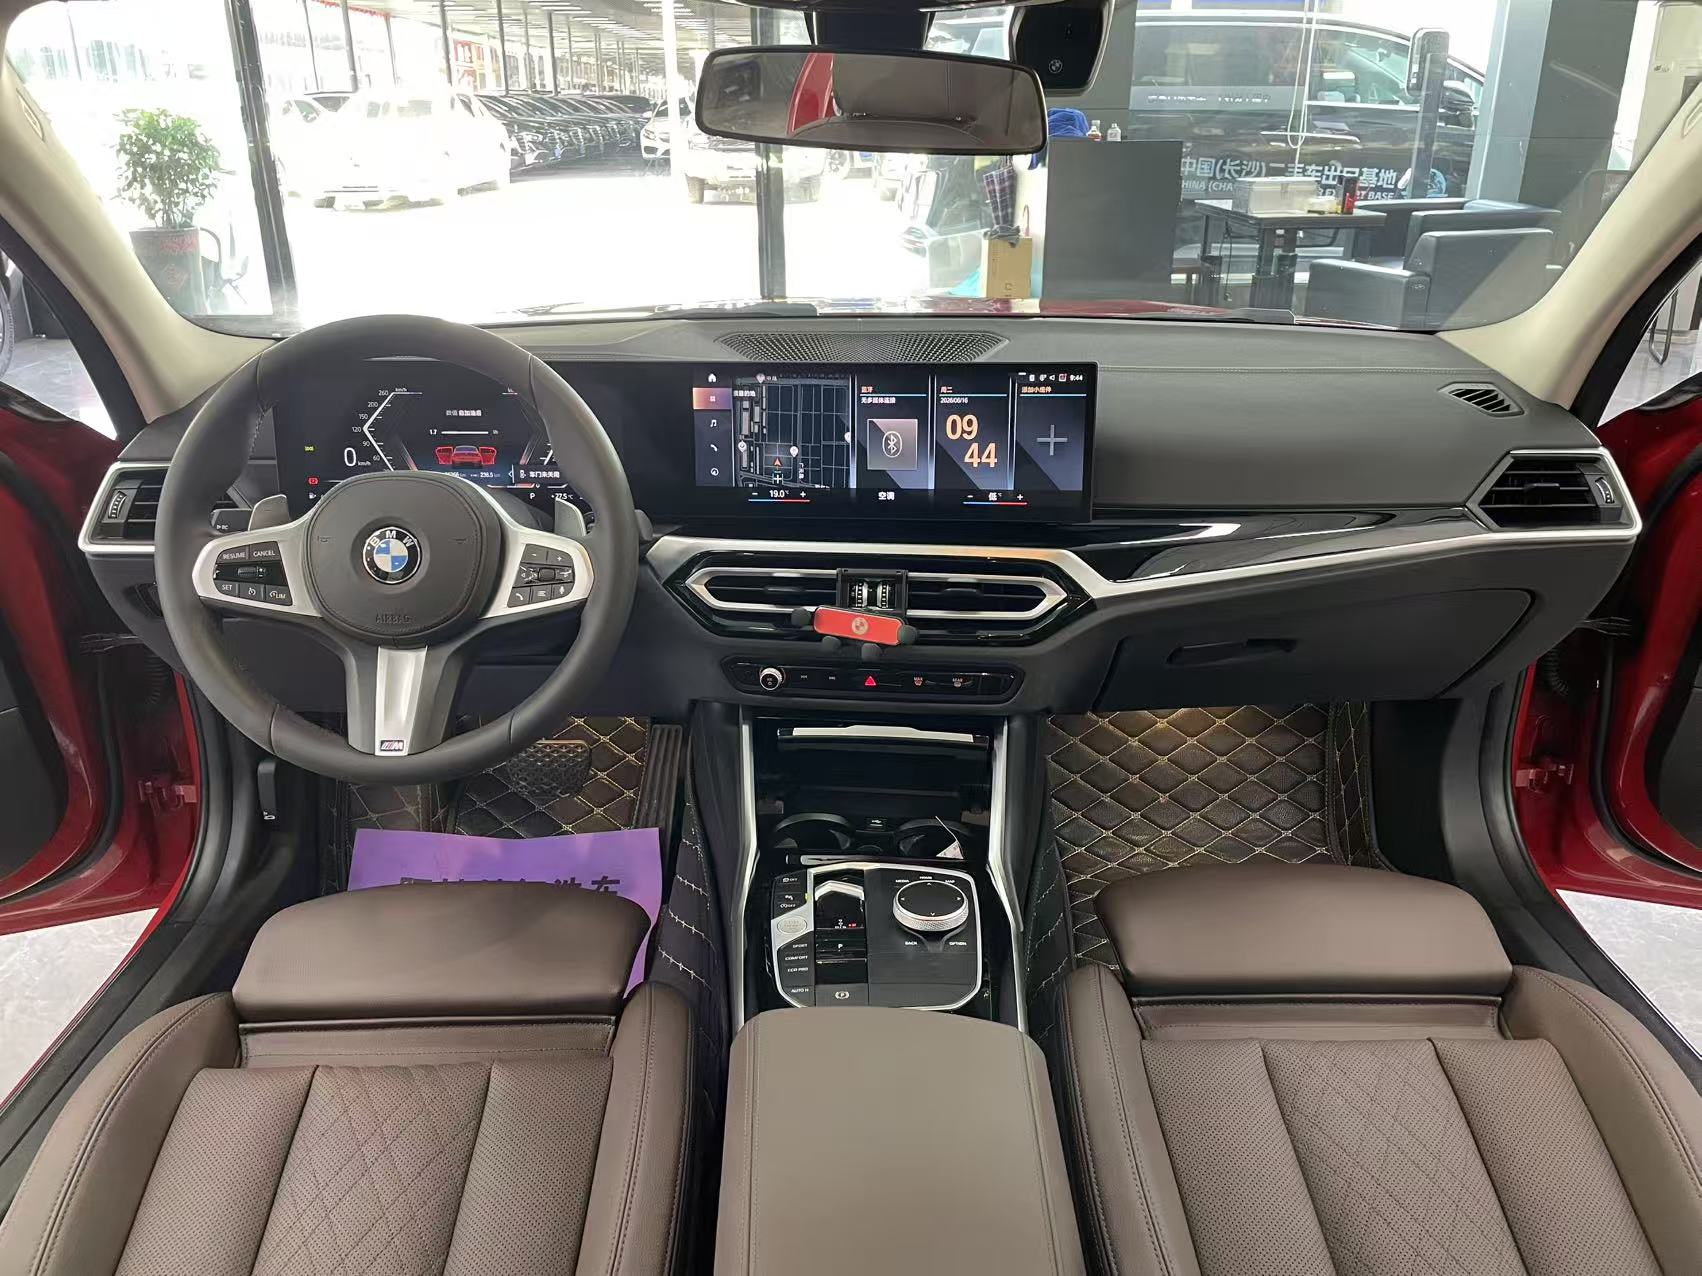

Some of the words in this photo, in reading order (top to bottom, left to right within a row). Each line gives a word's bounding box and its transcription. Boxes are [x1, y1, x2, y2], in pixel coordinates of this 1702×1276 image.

[1368, 191, 1394, 200] BASE
[945, 414, 979, 440] 09
[344, 447, 357, 467] 0
[964, 442, 998, 468] 44
[878, 491, 895, 501] 空调
[369, 530, 415, 547] BMW
[222, 551, 246, 560] RESUME
